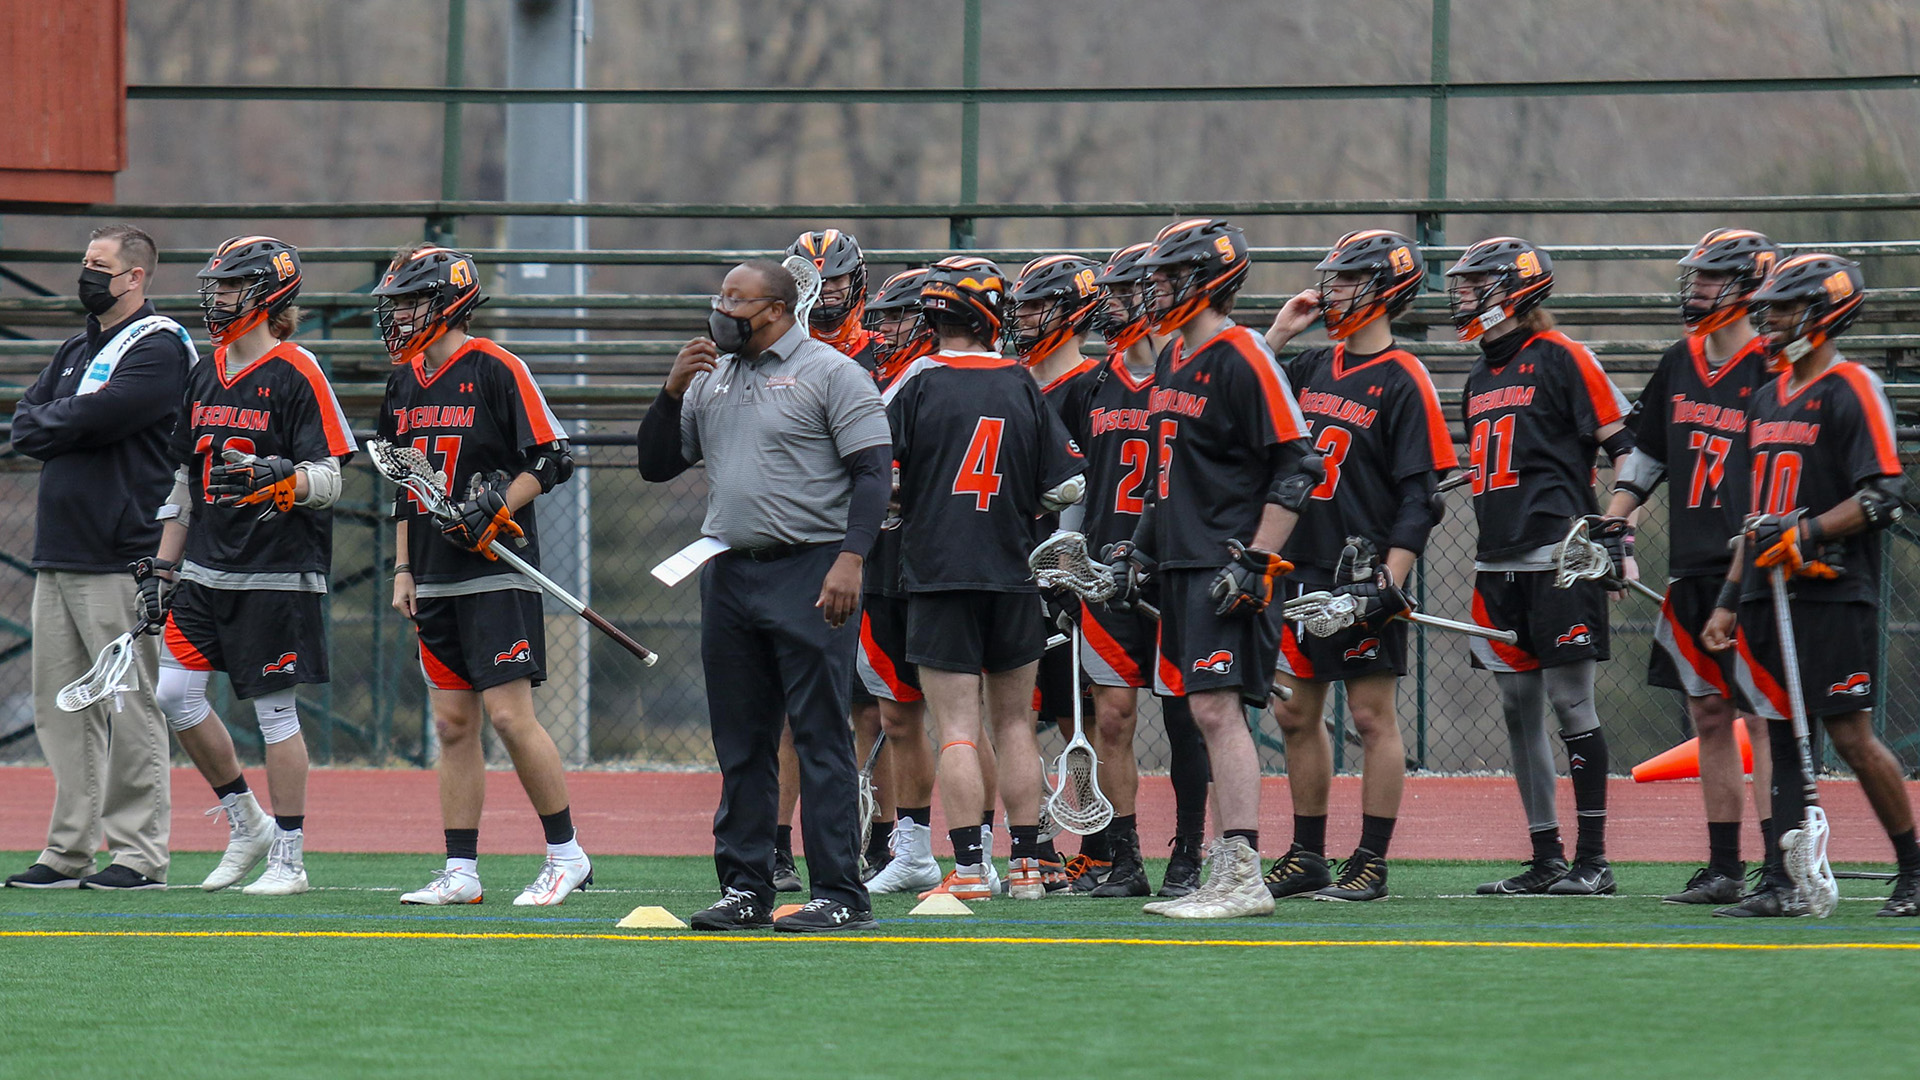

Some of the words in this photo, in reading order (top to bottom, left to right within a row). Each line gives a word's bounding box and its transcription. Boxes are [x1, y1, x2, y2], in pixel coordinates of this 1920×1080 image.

[1213, 235, 1236, 265] 5
[1388, 246, 1414, 277] 13
[1515, 250, 1543, 279] 91
[273, 251, 296, 281] 16
[450, 259, 472, 289] 47
[1089, 406, 1150, 438] TUSCUL
[951, 415, 1006, 512] 4
[1305, 419, 1353, 501] 3
[1470, 413, 1520, 497] 91
[1113, 437, 1150, 515] 2
